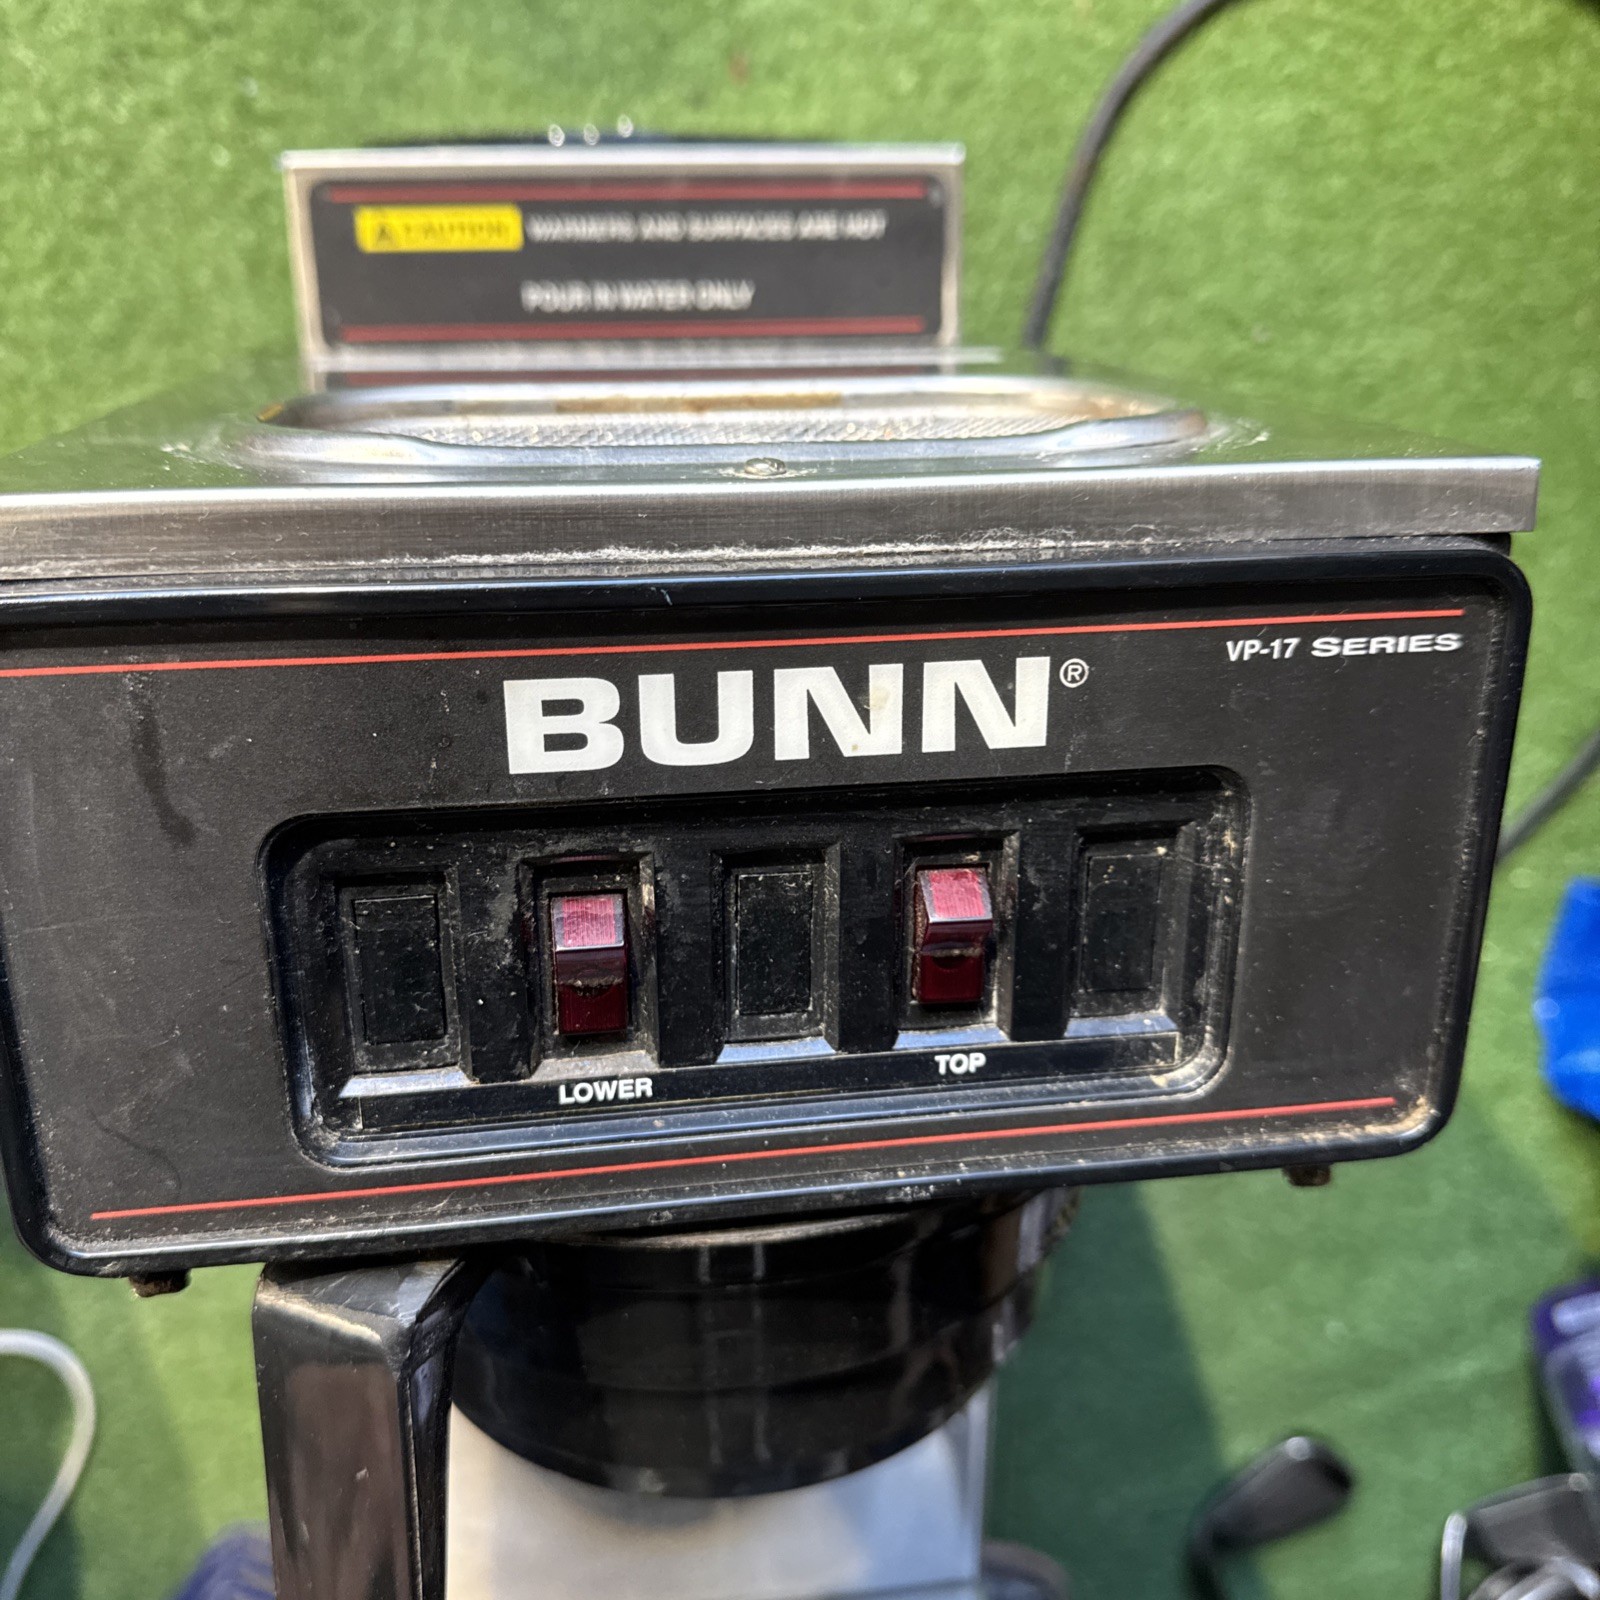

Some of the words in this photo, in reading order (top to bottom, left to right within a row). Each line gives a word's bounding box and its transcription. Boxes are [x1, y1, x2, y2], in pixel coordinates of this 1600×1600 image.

[639, 212, 685, 242] AND
[688, 210, 795, 242] SURFACES
[797, 210, 839, 241] ARE
[521, 279, 591, 313] POUR
[593, 279, 617, 312] IN
[618, 279, 695, 312] WATER
[696, 279, 756, 311] ONLY
[1226, 638, 1301, 662] VP-17
[1311, 633, 1462, 657] SERIES
[935, 1053, 987, 1075] TOP
[558, 1077, 653, 1103] LOWER
